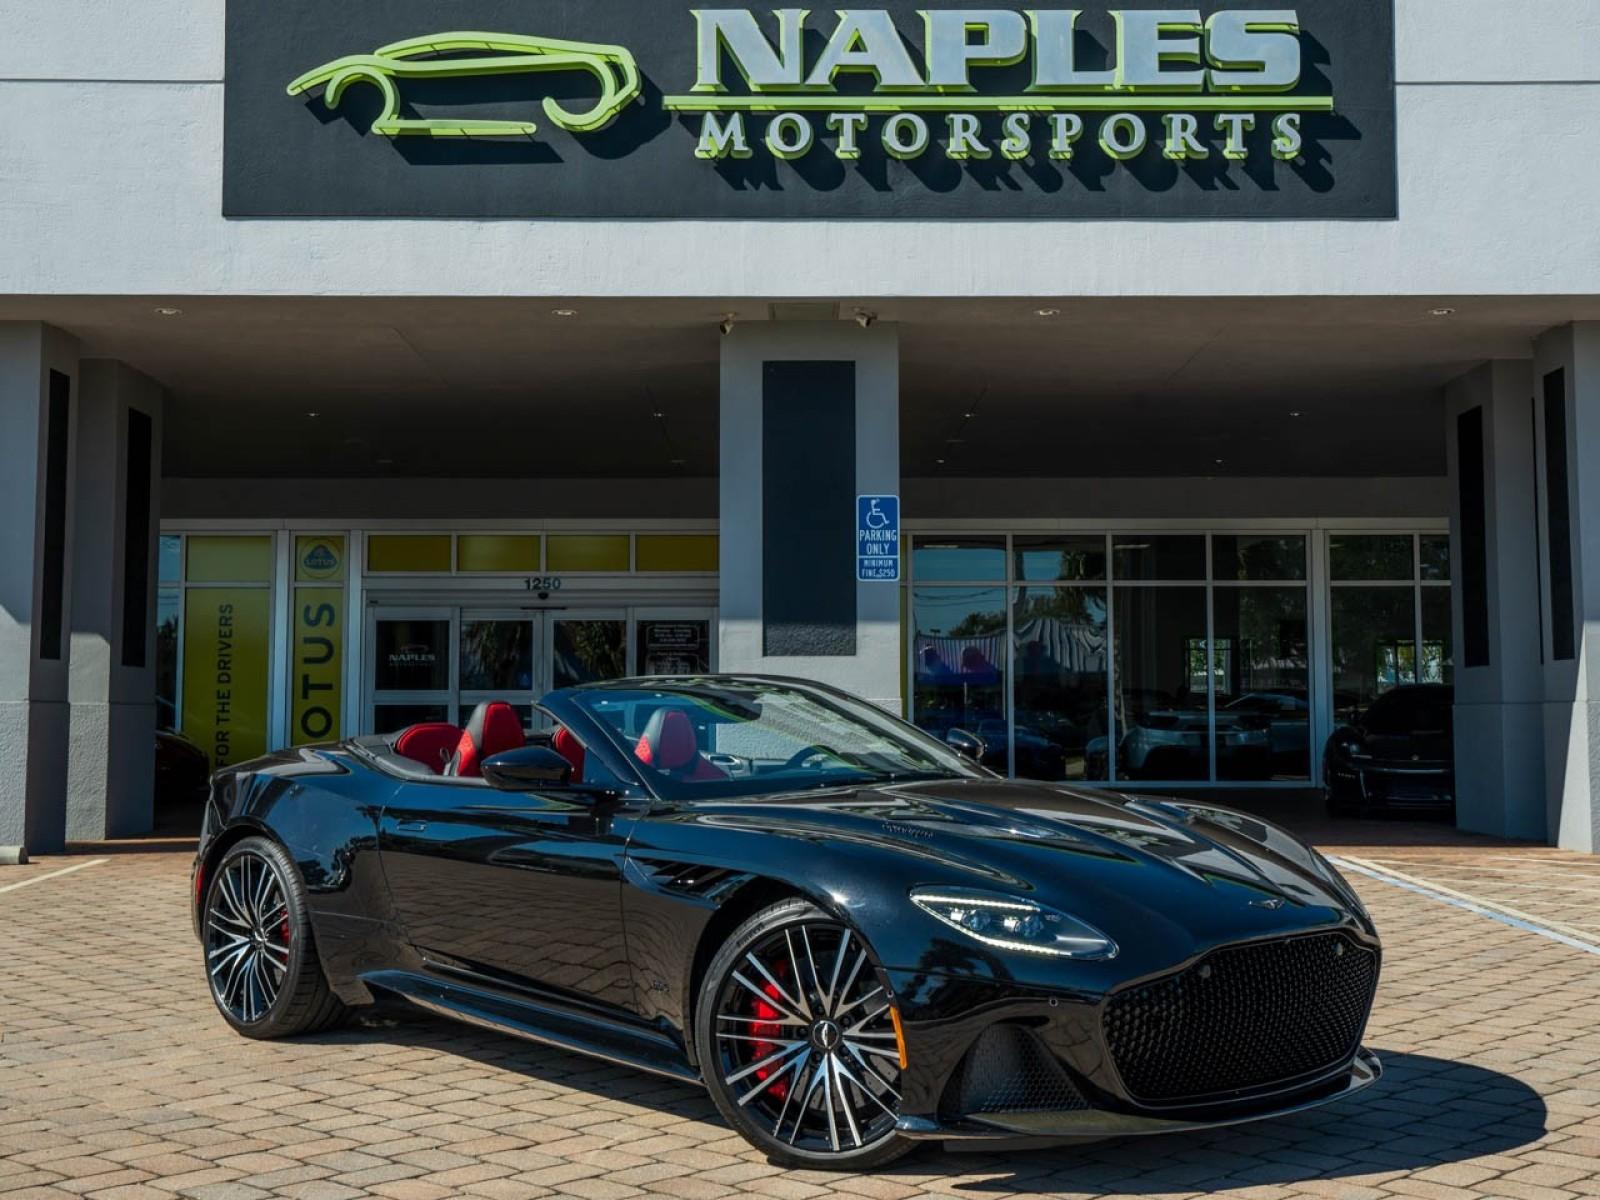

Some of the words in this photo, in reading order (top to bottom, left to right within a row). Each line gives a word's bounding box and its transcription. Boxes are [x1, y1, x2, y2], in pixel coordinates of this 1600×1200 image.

[690, 8, 1302, 92] NAPLES
[694, 112, 1303, 160] MOTORSPORTS
[859, 529, 896, 541] PARKING
[866, 543, 890, 554] ONLY
[524, 577, 562, 590] 1250
[861, 568, 877, 577] FINE
[878, 568, 895, 577] $250
[217, 604, 233, 684] DRIVERS
[301, 602, 336, 738] OTUS
[216, 687, 232, 725] THE
[215, 731, 230, 768] FOR
